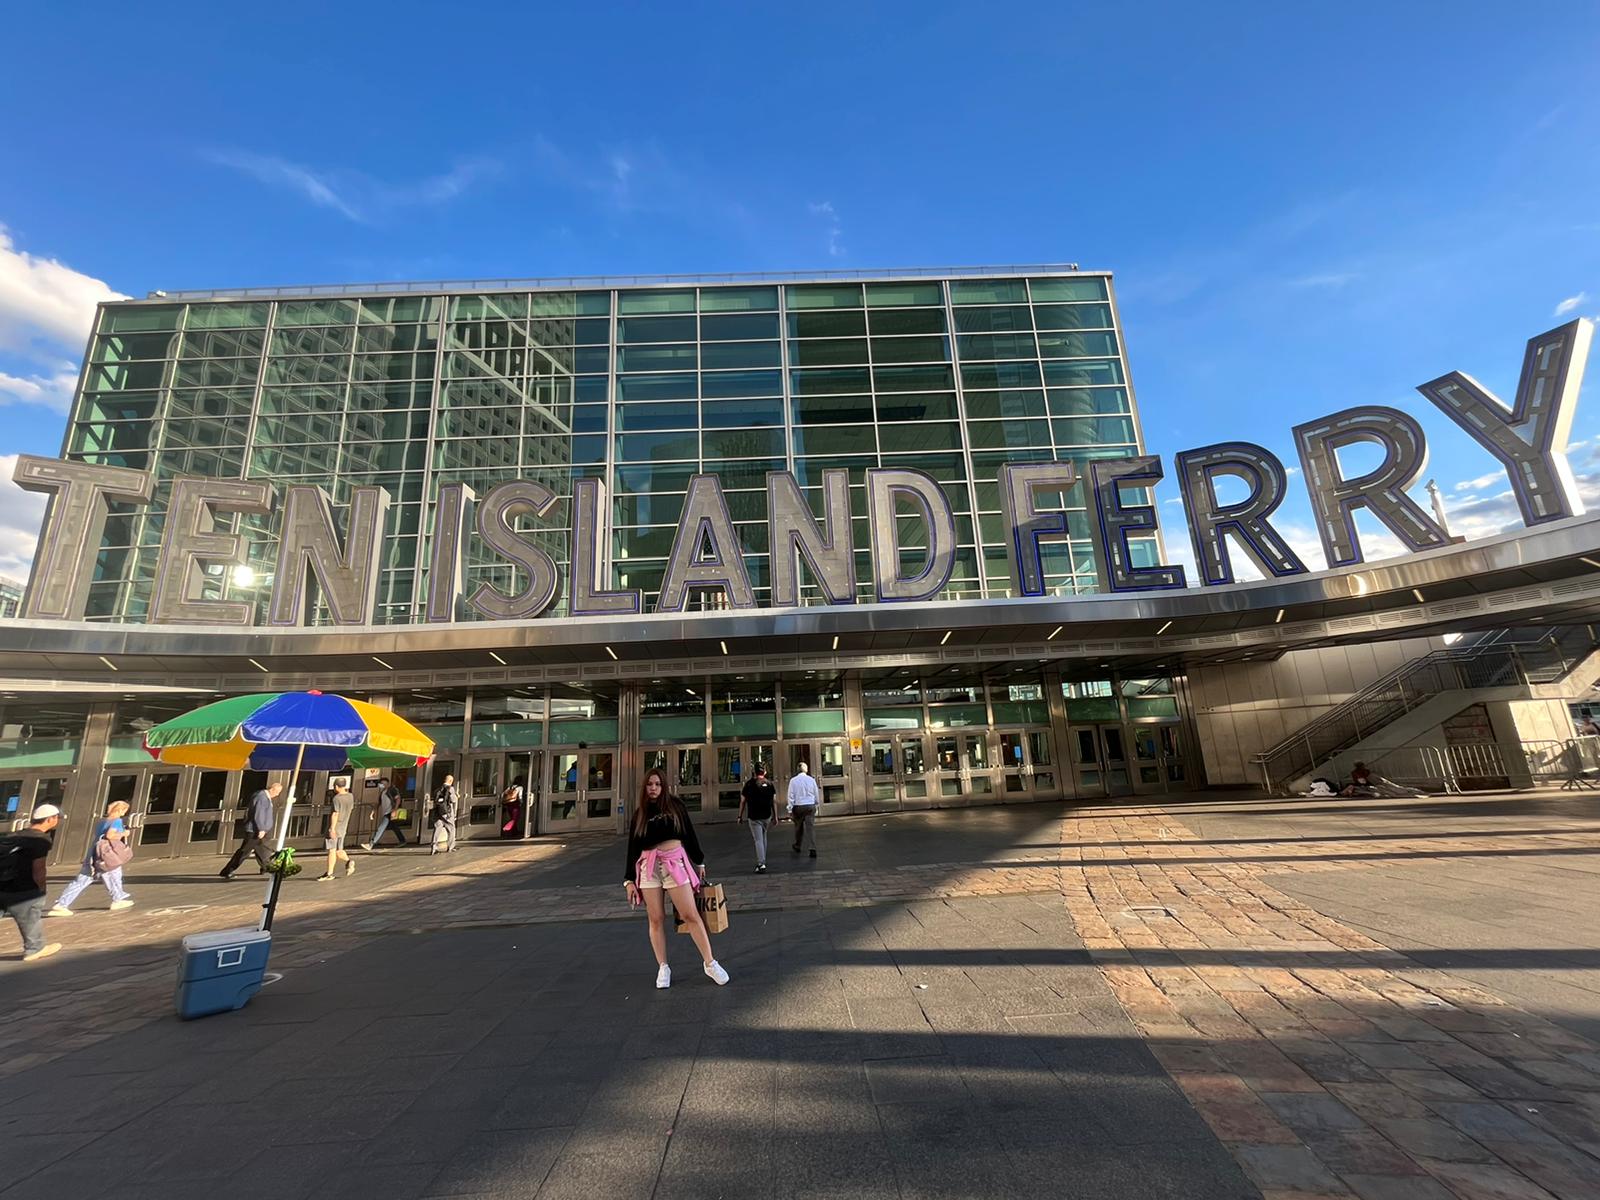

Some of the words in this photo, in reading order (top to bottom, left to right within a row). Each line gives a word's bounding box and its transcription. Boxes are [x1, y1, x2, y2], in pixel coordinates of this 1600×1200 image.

[12, 453, 391, 626] TEN
[424, 467, 957, 624] ISLAND
[1000, 317, 1592, 597] FERRY
